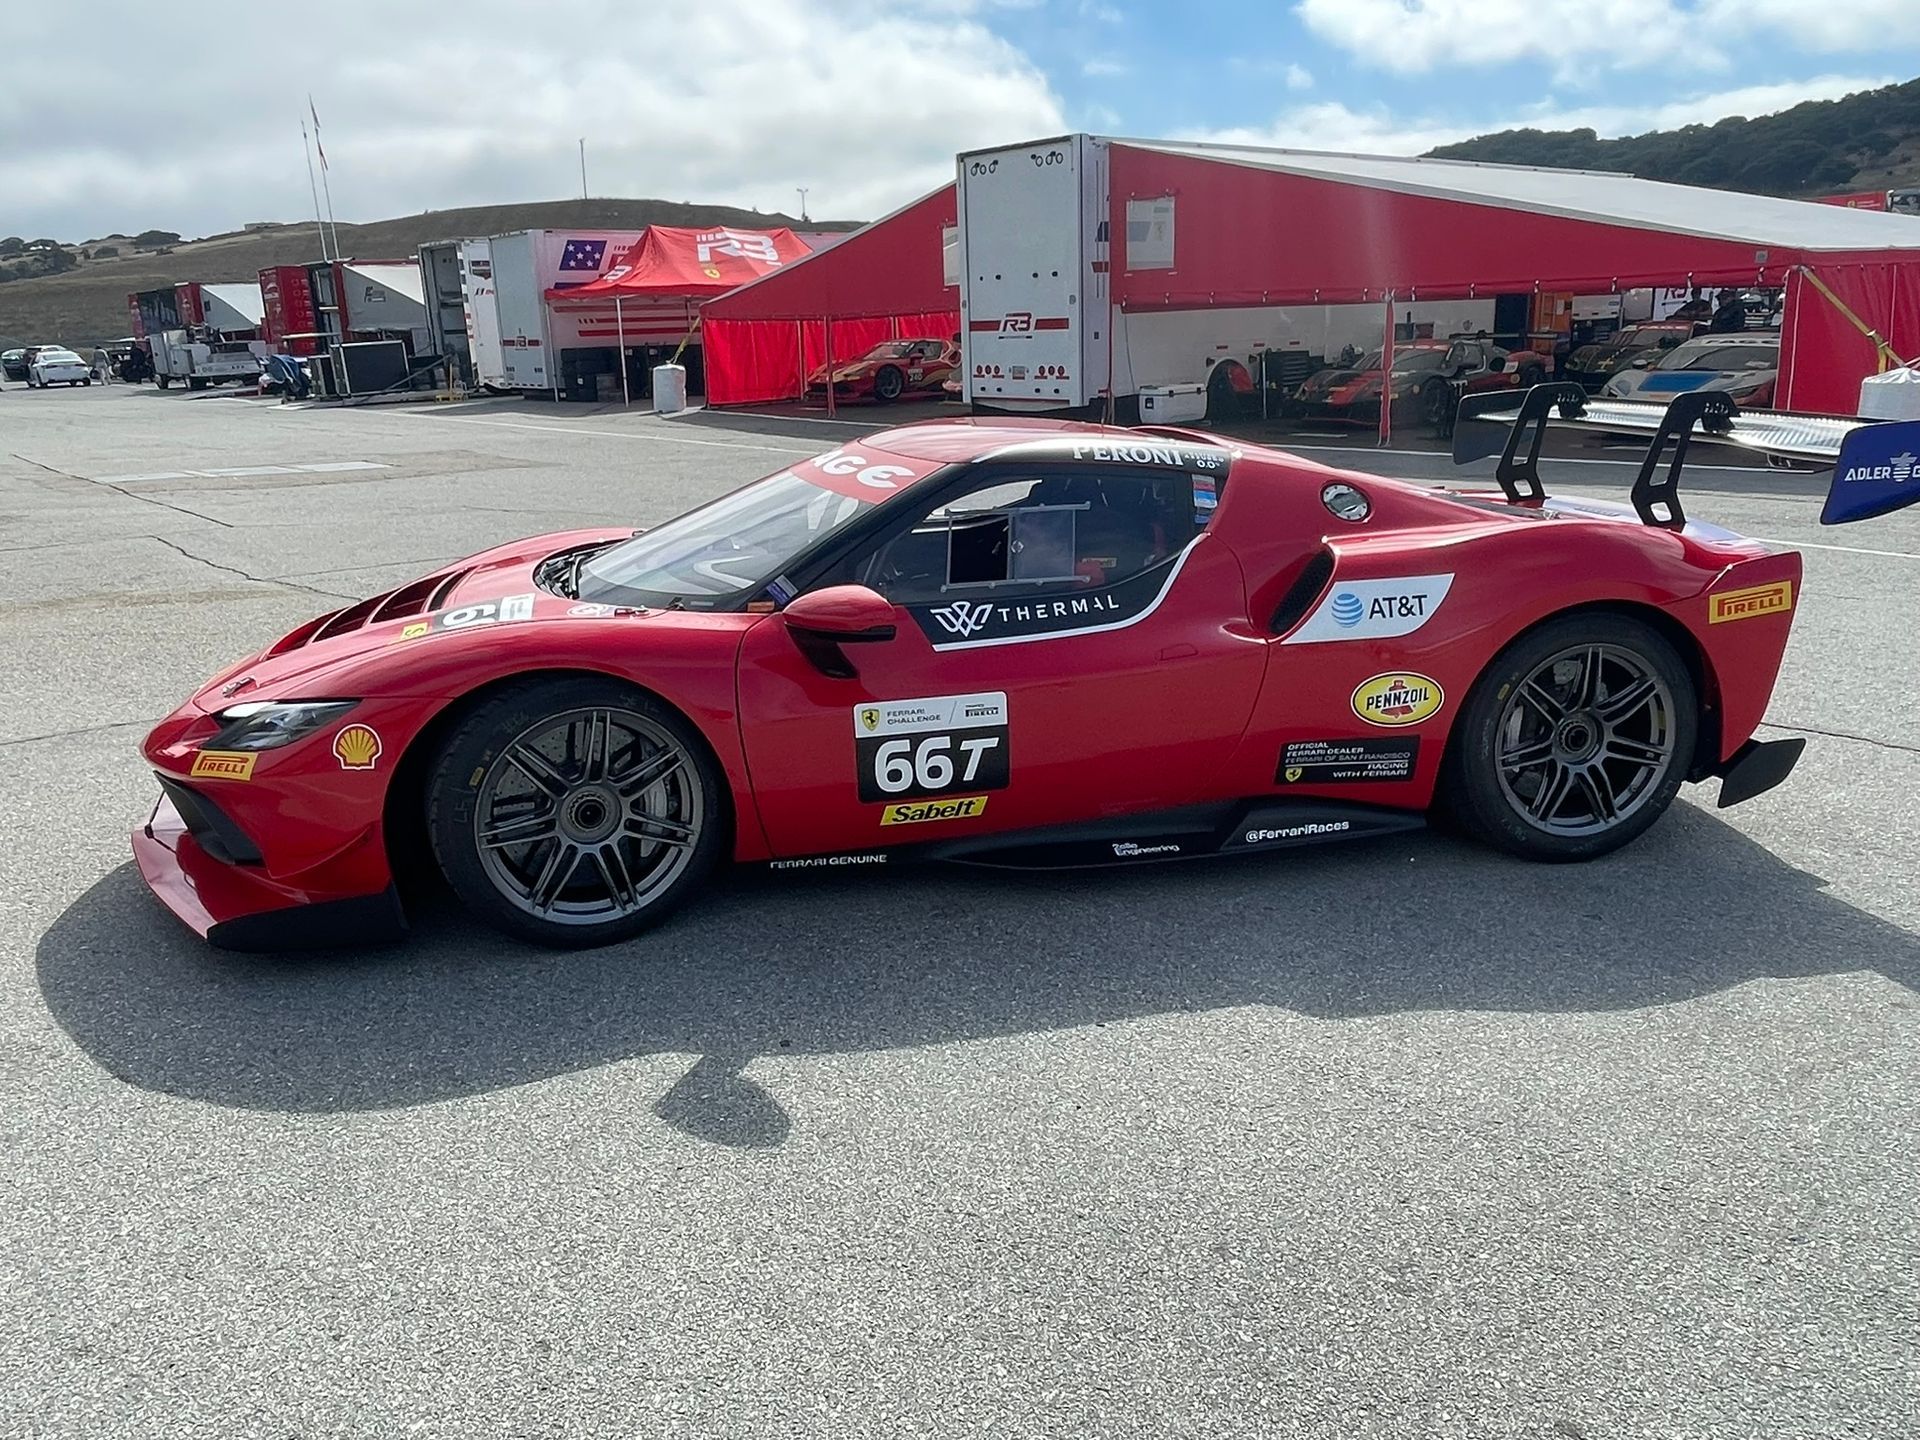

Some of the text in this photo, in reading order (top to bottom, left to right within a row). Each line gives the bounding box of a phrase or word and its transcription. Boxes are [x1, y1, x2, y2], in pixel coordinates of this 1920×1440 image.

[1073, 447, 1184, 465] PERONI
[1844, 466, 1891, 481] ADLER
[997, 594, 1120, 622] THERMAL
[1369, 594, 1428, 620] AT&T
[1717, 588, 1784, 617] PIRELLI
[1366, 687, 1430, 711] PENNZOIL
[887, 708, 925, 717] FERRARI
[887, 714, 941, 725] CHALLENGE
[1286, 747, 1364, 757] FERRARI DEALER
[1288, 742, 1329, 751] OFFICIAL
[196, 755, 250, 774] PIRELLI
[1285, 755, 1323, 763] FERRARI
[1359, 752, 1411, 760] FRANCISCO
[1332, 769, 1408, 778] WITH FERRARI
[1367, 762, 1409, 770] RACING
[891, 800, 976, 823] Sabelt
[1245, 821, 1350, 843] @FerrariRaces
[770, 854, 888, 869] FERRARI GENUINE
